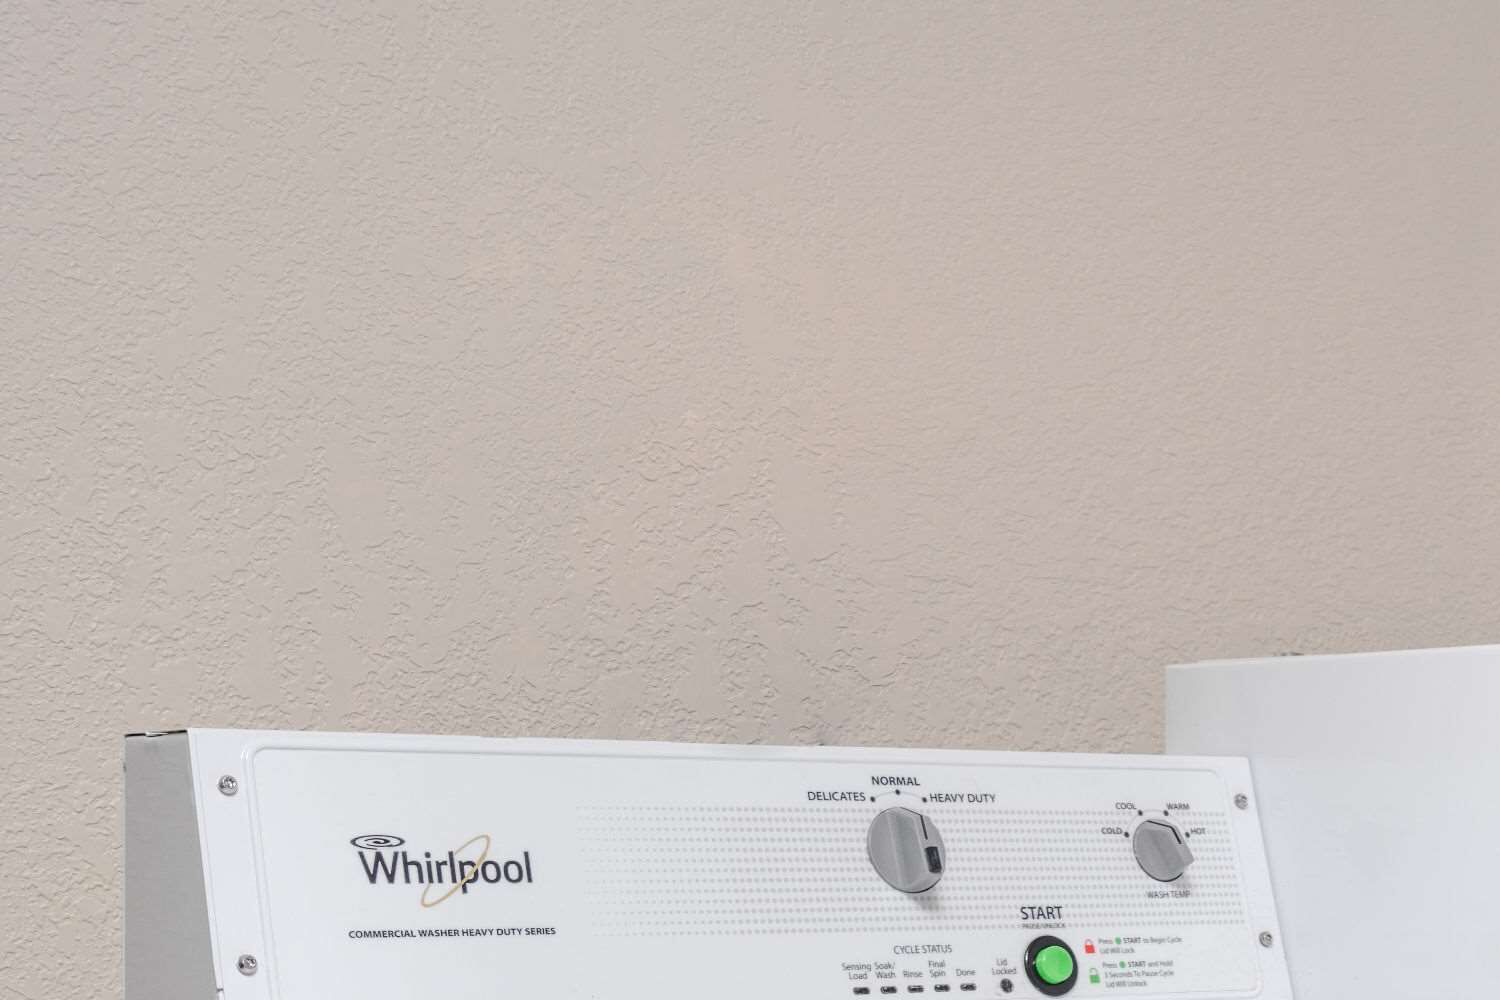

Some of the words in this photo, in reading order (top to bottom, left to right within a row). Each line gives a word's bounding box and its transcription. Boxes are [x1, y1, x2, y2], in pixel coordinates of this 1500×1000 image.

[871, 776, 921, 786] NORMAL
[807, 791, 866, 801] DELICATES
[930, 793, 965, 803] HEAVY
[967, 794, 996, 803] DUTY
[1115, 802, 1137, 810] COOL
[1101, 827, 1123, 835] COLD
[1190, 827, 1206, 835] HOT
[358, 850, 533, 894] Whirlpool
[1020, 906, 1063, 920] START
[348, 929, 416, 939] COMMERCIAL
[418, 928, 460, 938] WASHER
[462, 928, 494, 937] HEAVY
[496, 927, 522, 936] DUTY
[525, 927, 556, 936] SERIES
[893, 945, 920, 955] CYCLE
[921, 944, 953, 954] STATUS
[874, 961, 896, 970] Soak/
[928, 959, 946, 968] Final
[996, 958, 1008, 966] Lid
[841, 962, 872, 972] Sensing
[848, 972, 868, 980] Load
[875, 970, 897, 979] Wash
[929, 970, 946, 979] Spin
[956, 968, 976, 977] Done
